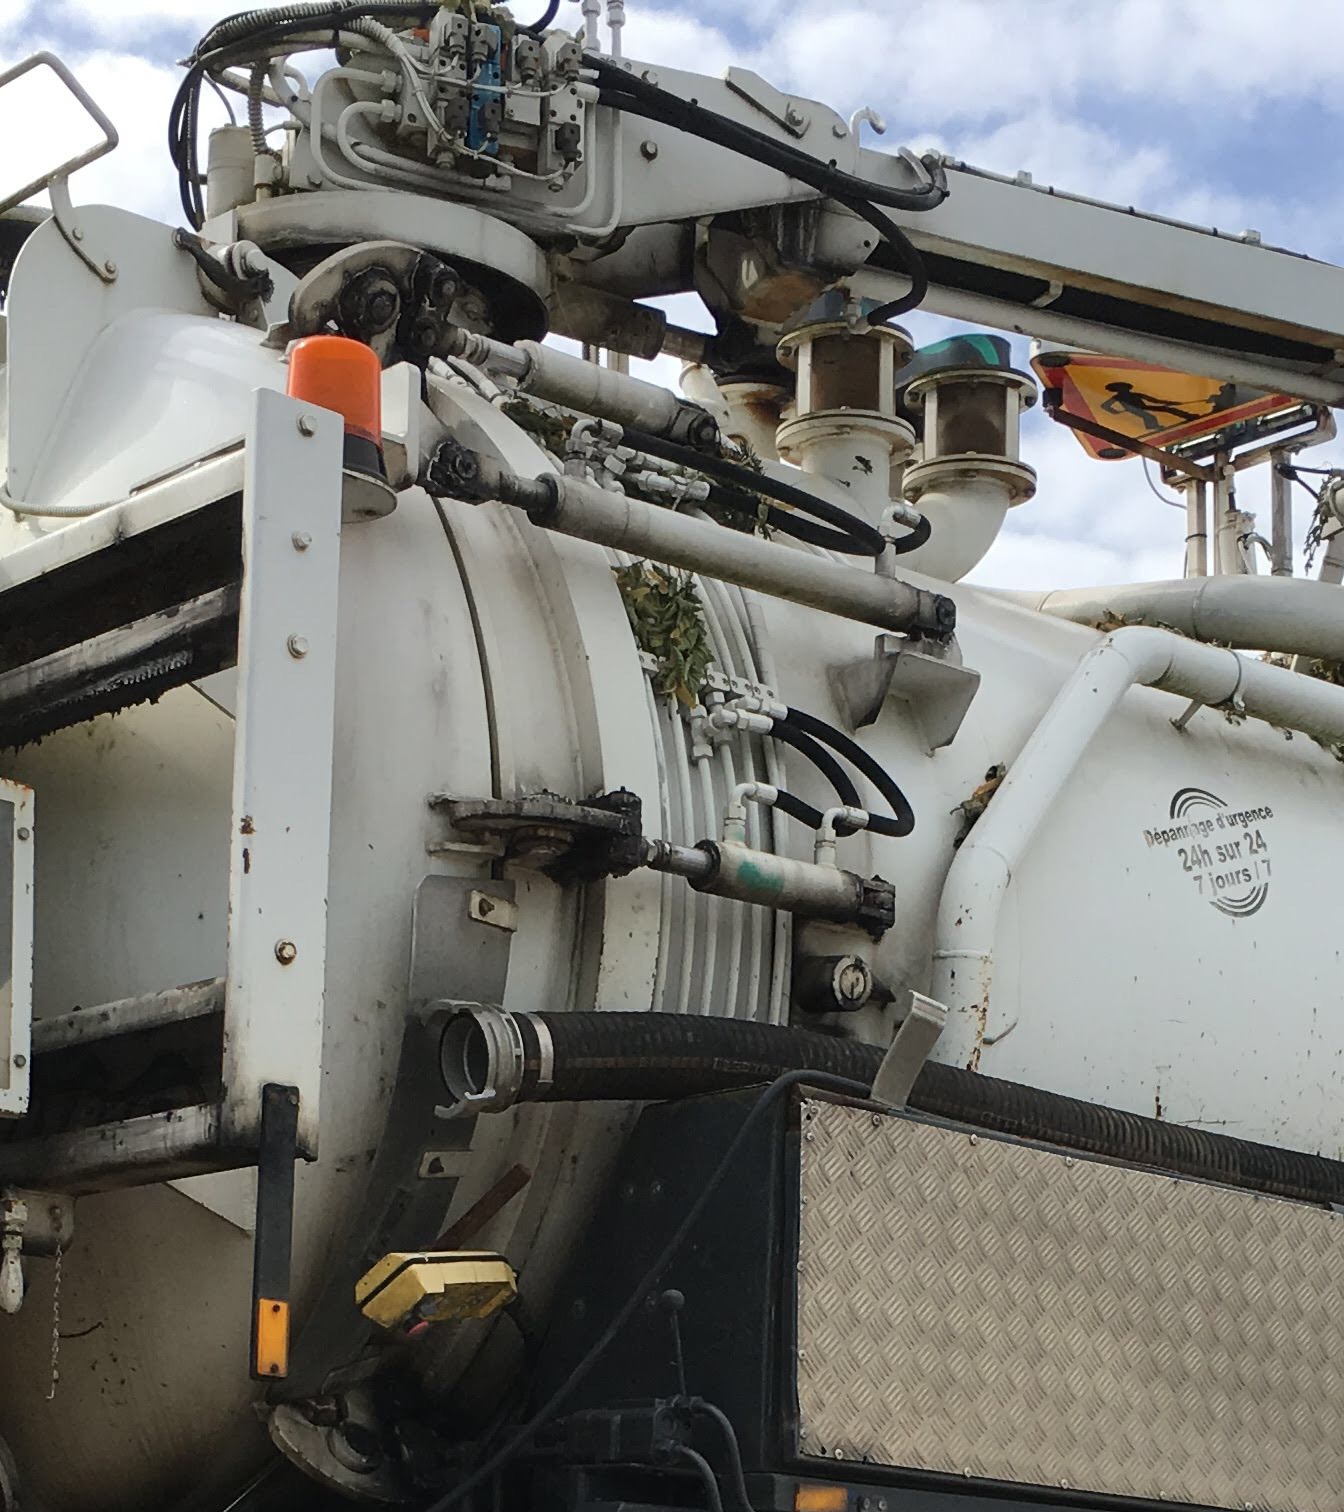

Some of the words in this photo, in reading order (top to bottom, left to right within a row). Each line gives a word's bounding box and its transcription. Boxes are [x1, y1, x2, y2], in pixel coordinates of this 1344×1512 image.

[1216, 806, 1274, 829] d'urgence
[1177, 844, 1214, 873] 24h
[1216, 840, 1242, 864] sur
[1243, 829, 1268, 856] 24
[1193, 875, 1203, 895] 7
[1208, 868, 1252, 896] jours
[1260, 858, 1272, 877] 7
